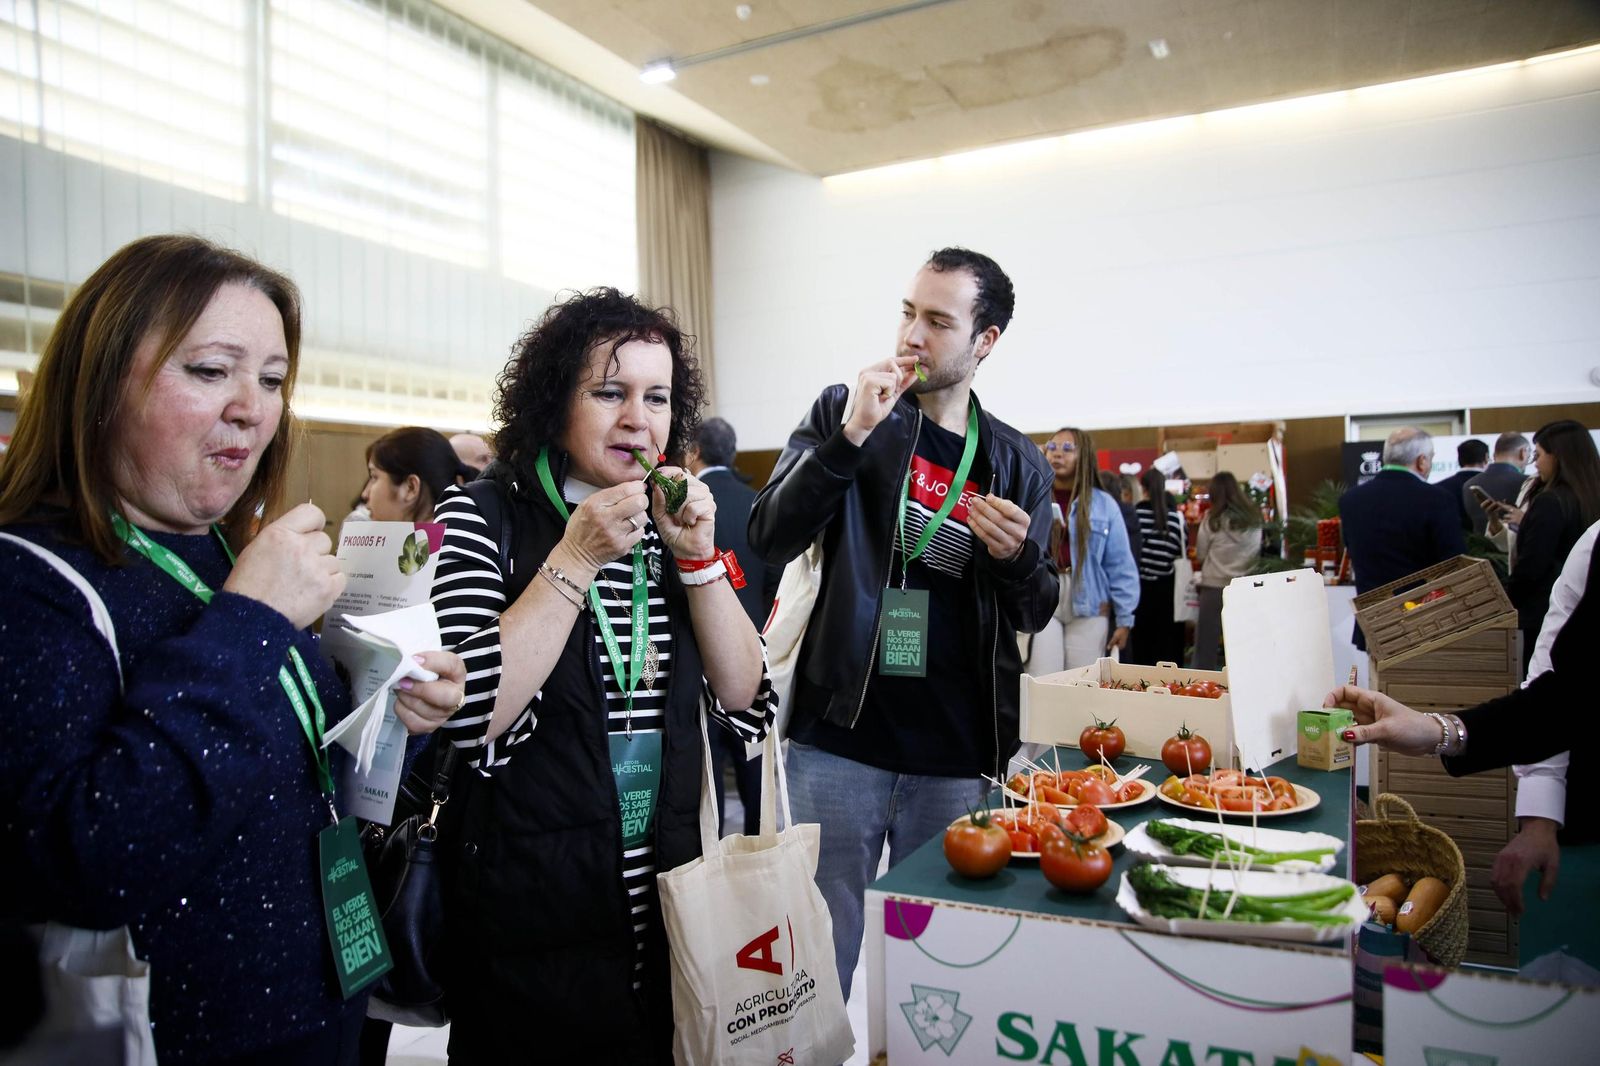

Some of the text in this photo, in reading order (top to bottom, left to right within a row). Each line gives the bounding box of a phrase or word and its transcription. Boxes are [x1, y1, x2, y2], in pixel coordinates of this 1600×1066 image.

[926, 480, 973, 509] JOES
[897, 630, 920, 638] VERDE
[635, 645, 643, 661] ESTO
[886, 651, 920, 666] BIEN
[887, 644, 920, 653] TAAAAN
[363, 786, 389, 799] SAKATA
[623, 790, 652, 801] VERDE
[620, 799, 651, 811] OS SABE
[622, 807, 650, 820] AAAN
[622, 817, 648, 837] IEN
[332, 892, 368, 921] EL VERDE
[335, 905, 371, 934] NOS SABE
[337, 917, 375, 949] TAAAAN
[341, 930, 382, 975] BIEN
[735, 969, 808, 1015] AGRICULRA
[727, 1013, 756, 1034] CON
[995, 1011, 1298, 1066] SAKA
